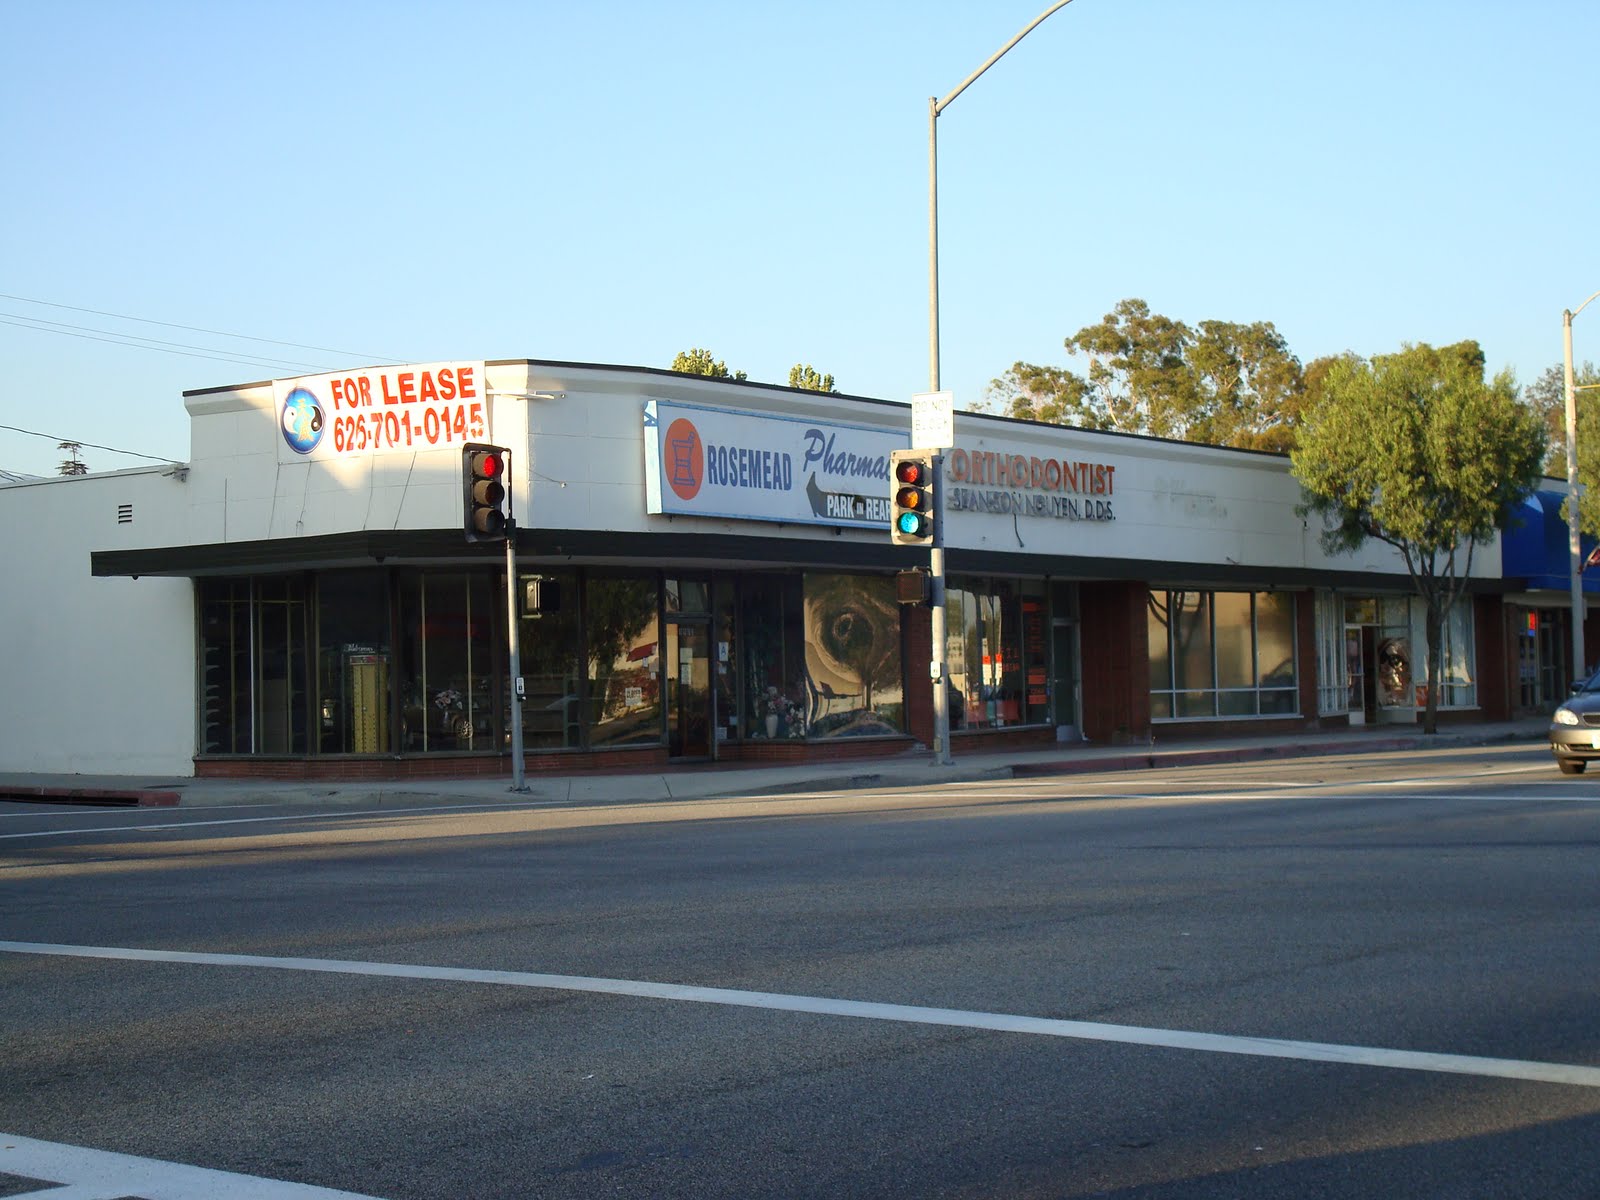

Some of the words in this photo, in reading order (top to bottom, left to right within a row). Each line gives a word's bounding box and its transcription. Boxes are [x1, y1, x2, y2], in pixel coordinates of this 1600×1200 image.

[331, 377, 372, 410] FOR
[381, 367, 477, 405] LEASE
[914, 400, 928, 413] DO
[931, 399, 948, 412] NOT
[707, 445, 792, 492] ROSEMEAD
[803, 429, 891, 482] Pharma
[951, 448, 1115, 495] ORTHODONTIST
[826, 494, 855, 518] PARK
[856, 502, 864, 515] IN
[1085, 499, 1116, 520] D.D.S.
